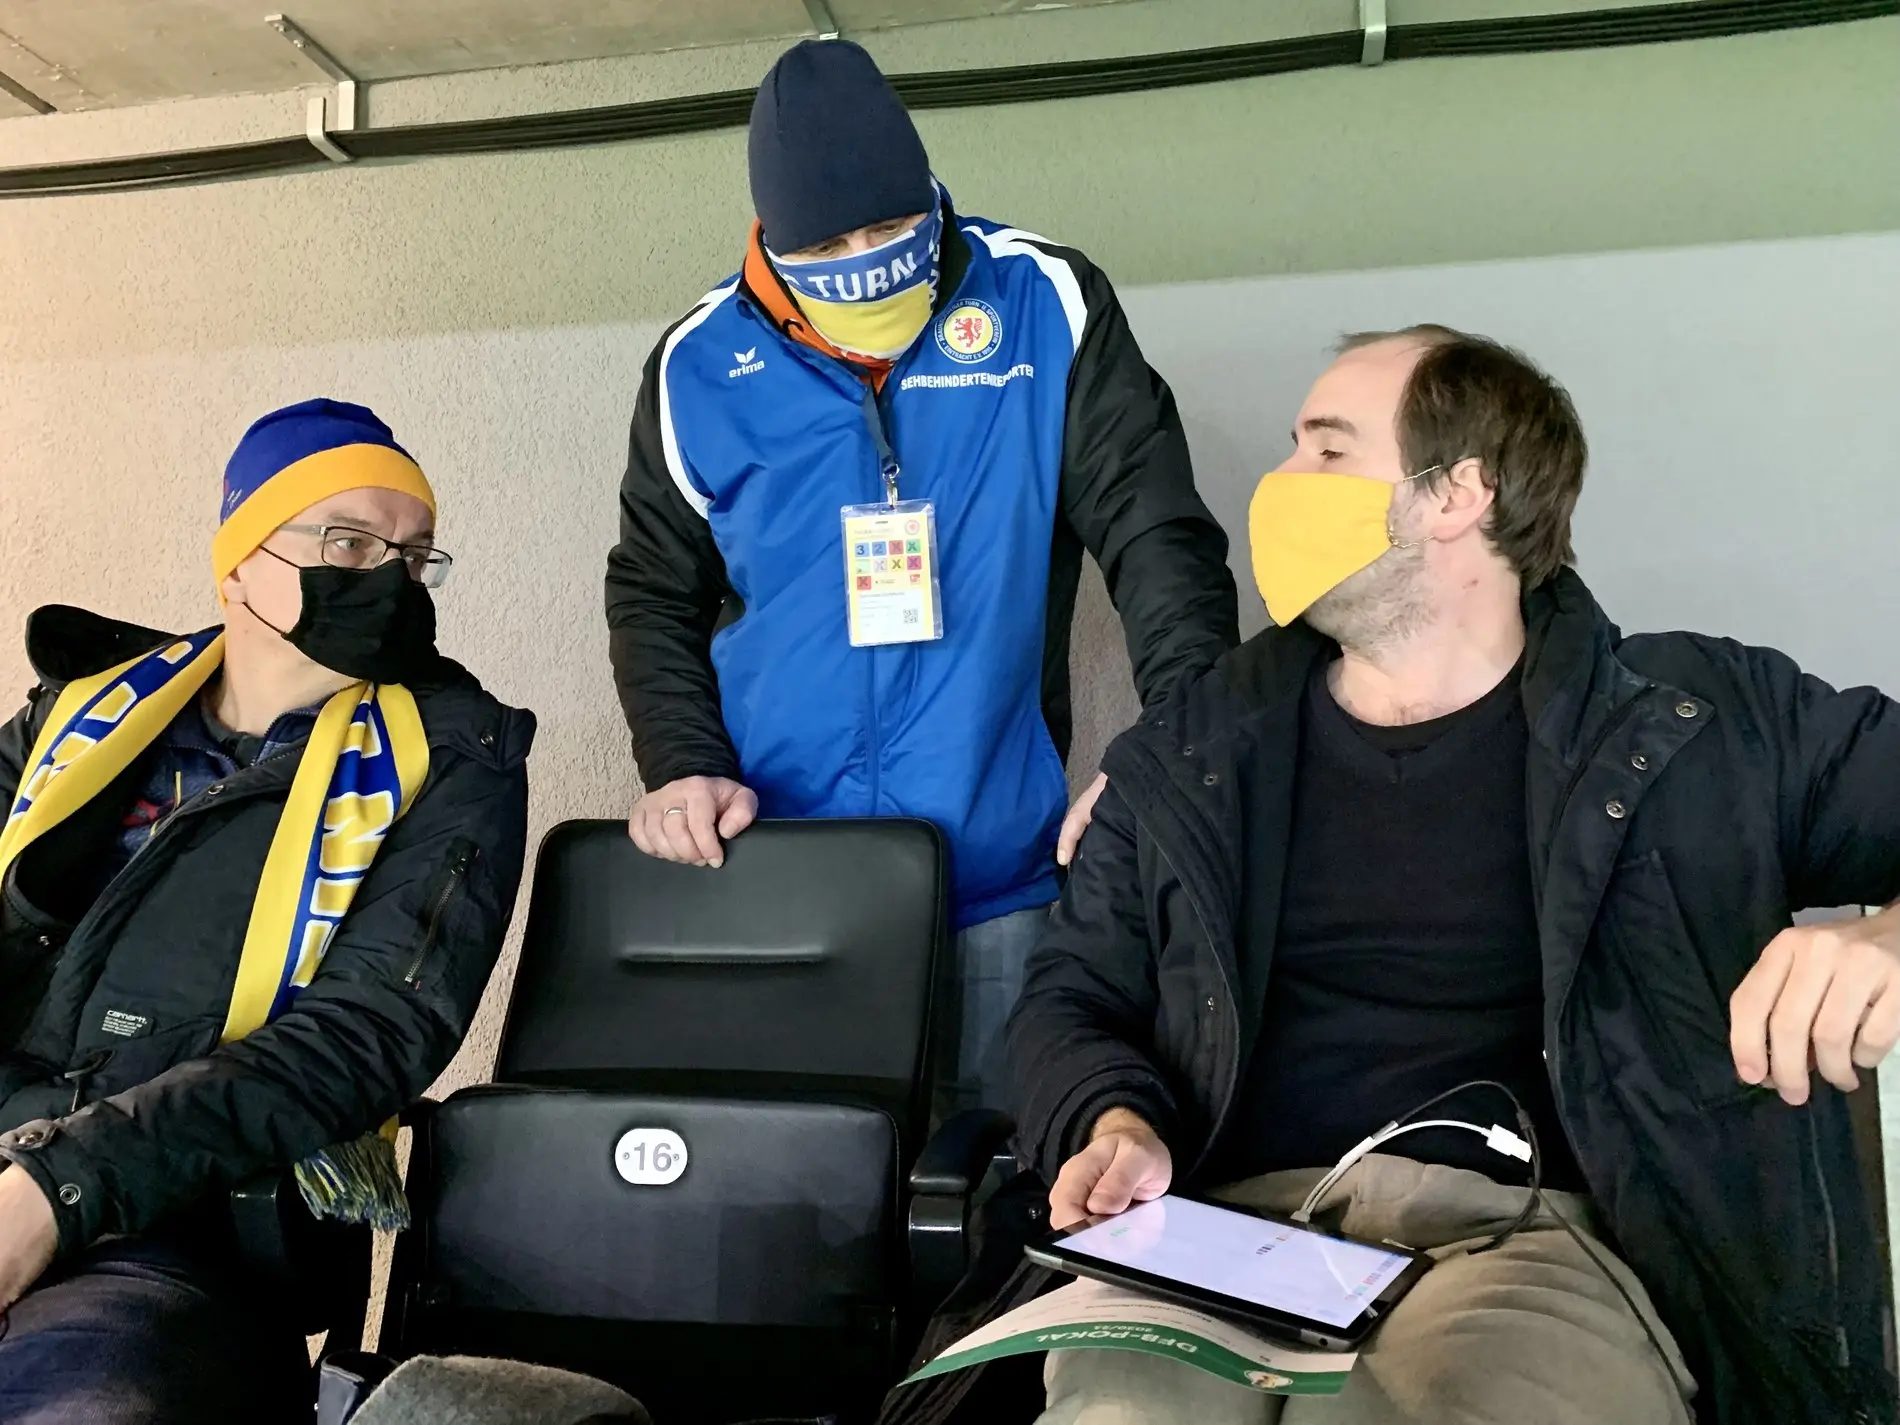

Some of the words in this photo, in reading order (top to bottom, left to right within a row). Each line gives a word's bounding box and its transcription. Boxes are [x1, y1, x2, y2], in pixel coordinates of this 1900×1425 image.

[808, 252, 917, 301] TURN
[728, 360, 765, 378] erima
[857, 545, 865, 556] 3
[892, 559, 902, 570] X
[633, 1142, 672, 1172] 16
[1036, 1330, 1198, 1353] DFB-POKAL
